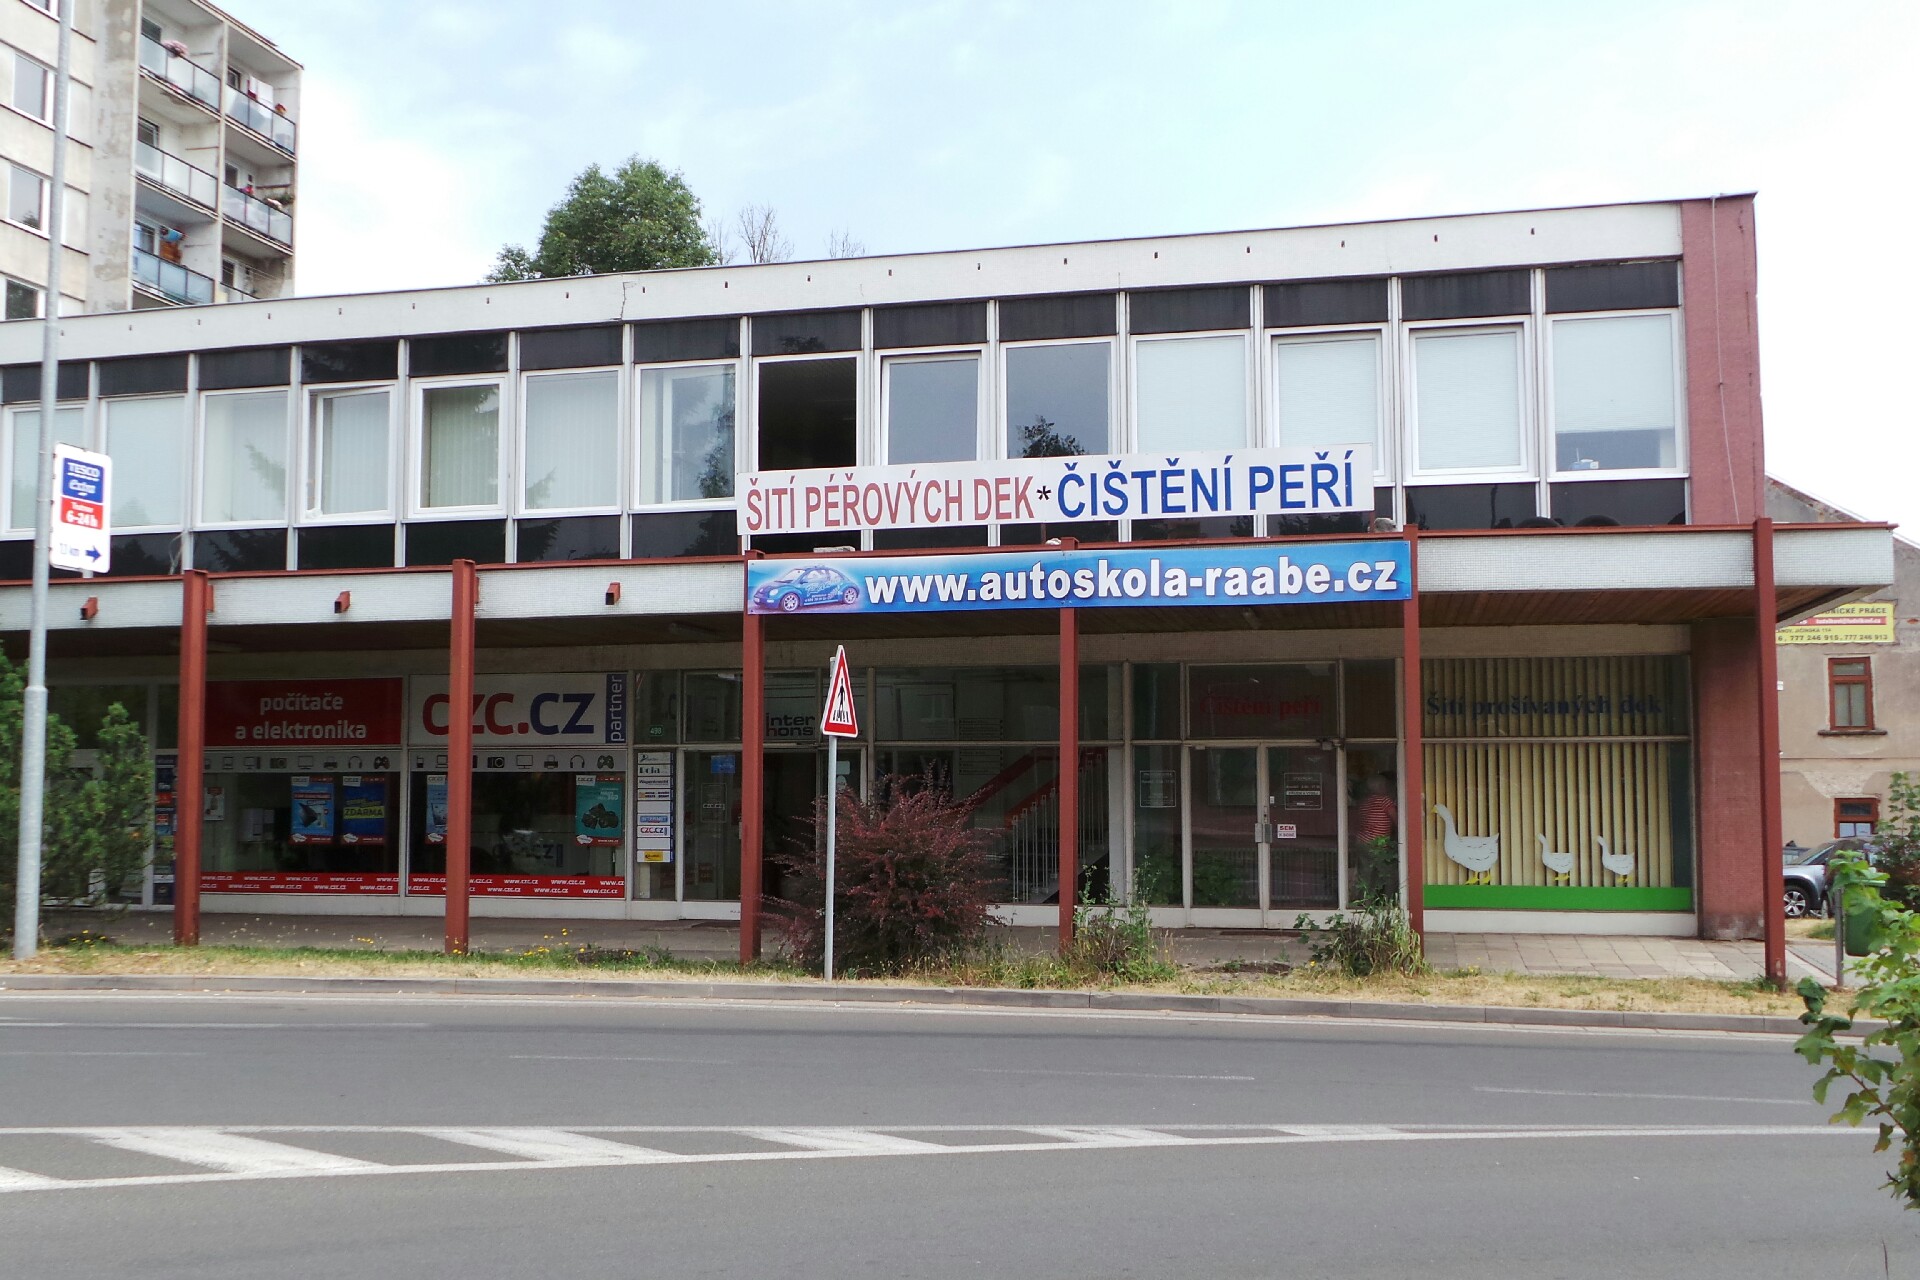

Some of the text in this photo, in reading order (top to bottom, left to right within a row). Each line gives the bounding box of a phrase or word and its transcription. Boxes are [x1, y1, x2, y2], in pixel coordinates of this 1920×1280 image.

[67, 463, 100, 477] TESCO
[1249, 449, 1354, 510] PEŘÍ
[746, 475, 795, 531] ŠITÍ
[805, 469, 963, 528] PÉŘOVÝCH
[865, 556, 1397, 604] www.autoskola-raabe.cz
[1858, 606, 1887, 614] PRÁCE
[260, 692, 344, 715] počítače
[610, 675, 624, 742] partner
[1426, 691, 1664, 721] Šití prošívaných dek
[235, 720, 368, 739] a elektronika
[766, 713, 816, 727] inter
[344, 807, 383, 817] ZDARMA
